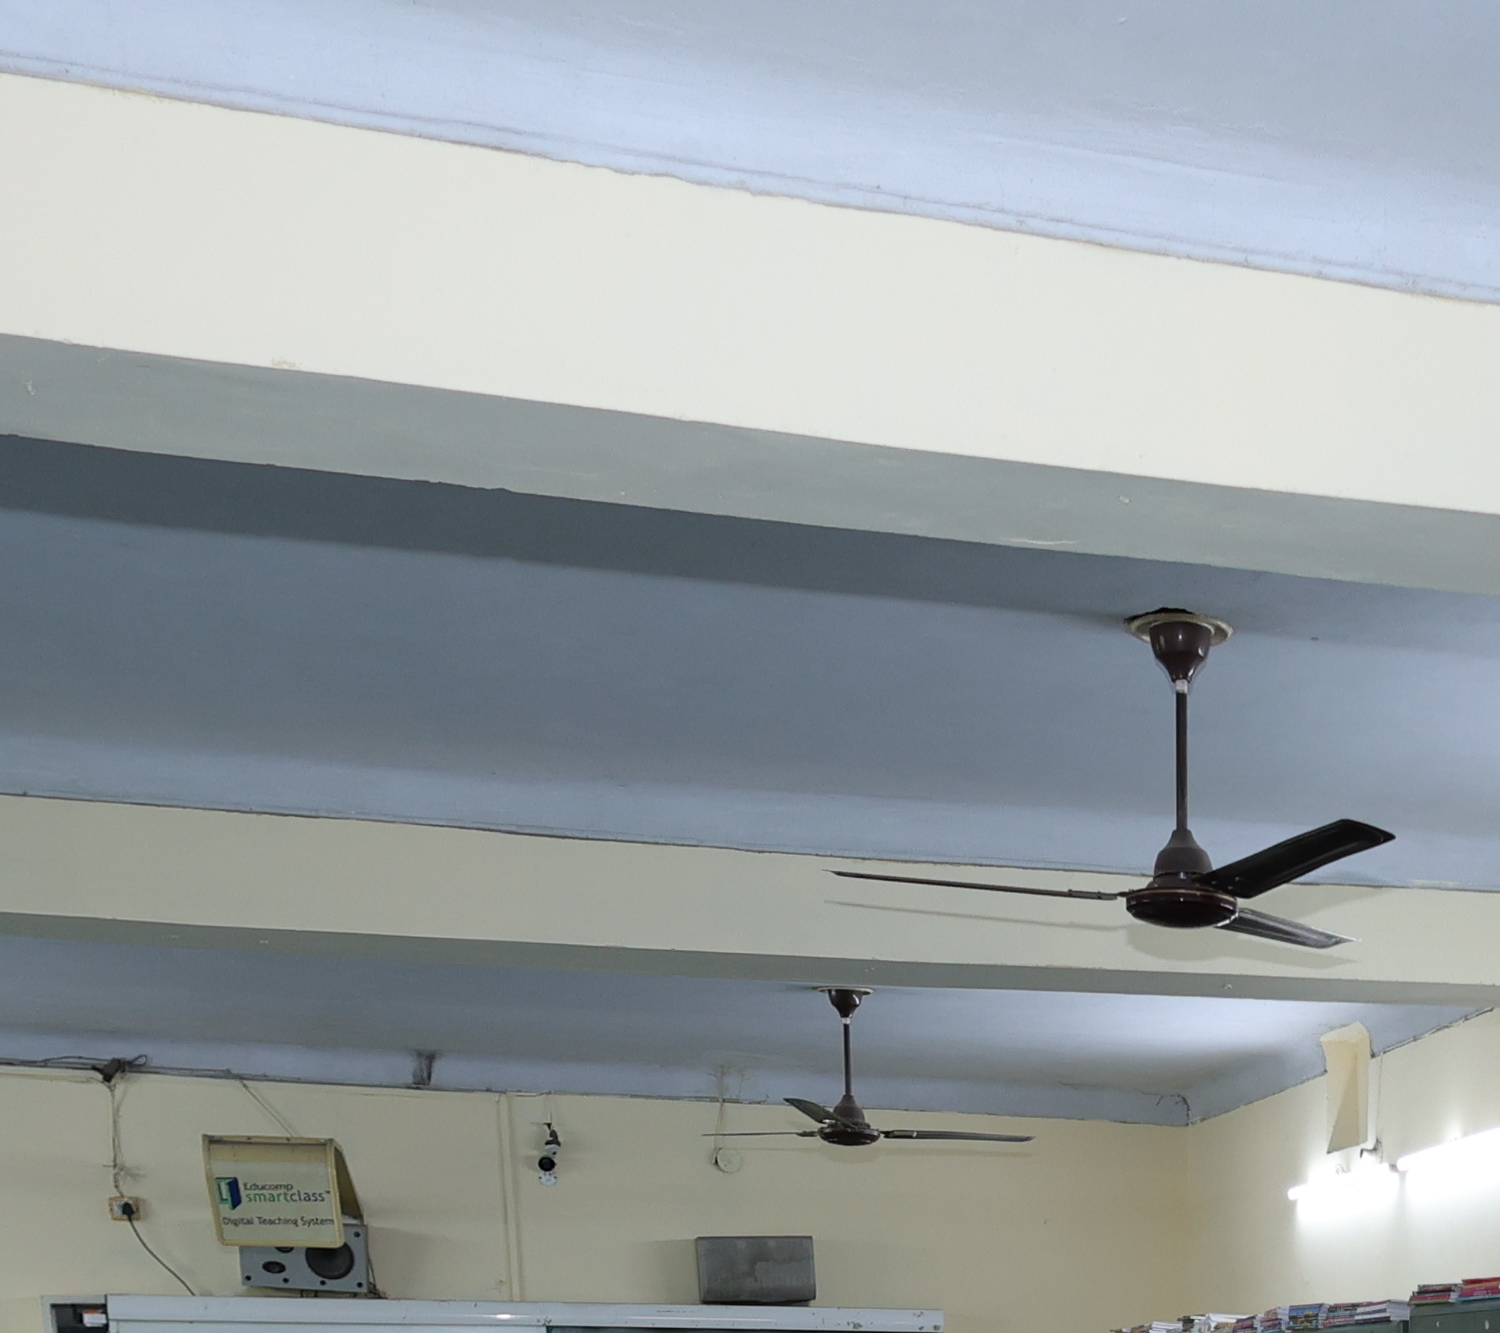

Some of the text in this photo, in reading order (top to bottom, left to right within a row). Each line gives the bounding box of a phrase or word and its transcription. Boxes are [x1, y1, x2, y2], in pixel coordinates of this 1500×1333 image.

[243, 1182, 294, 1193] Educomp
[222, 1216, 335, 1228] Digital Teaching System
